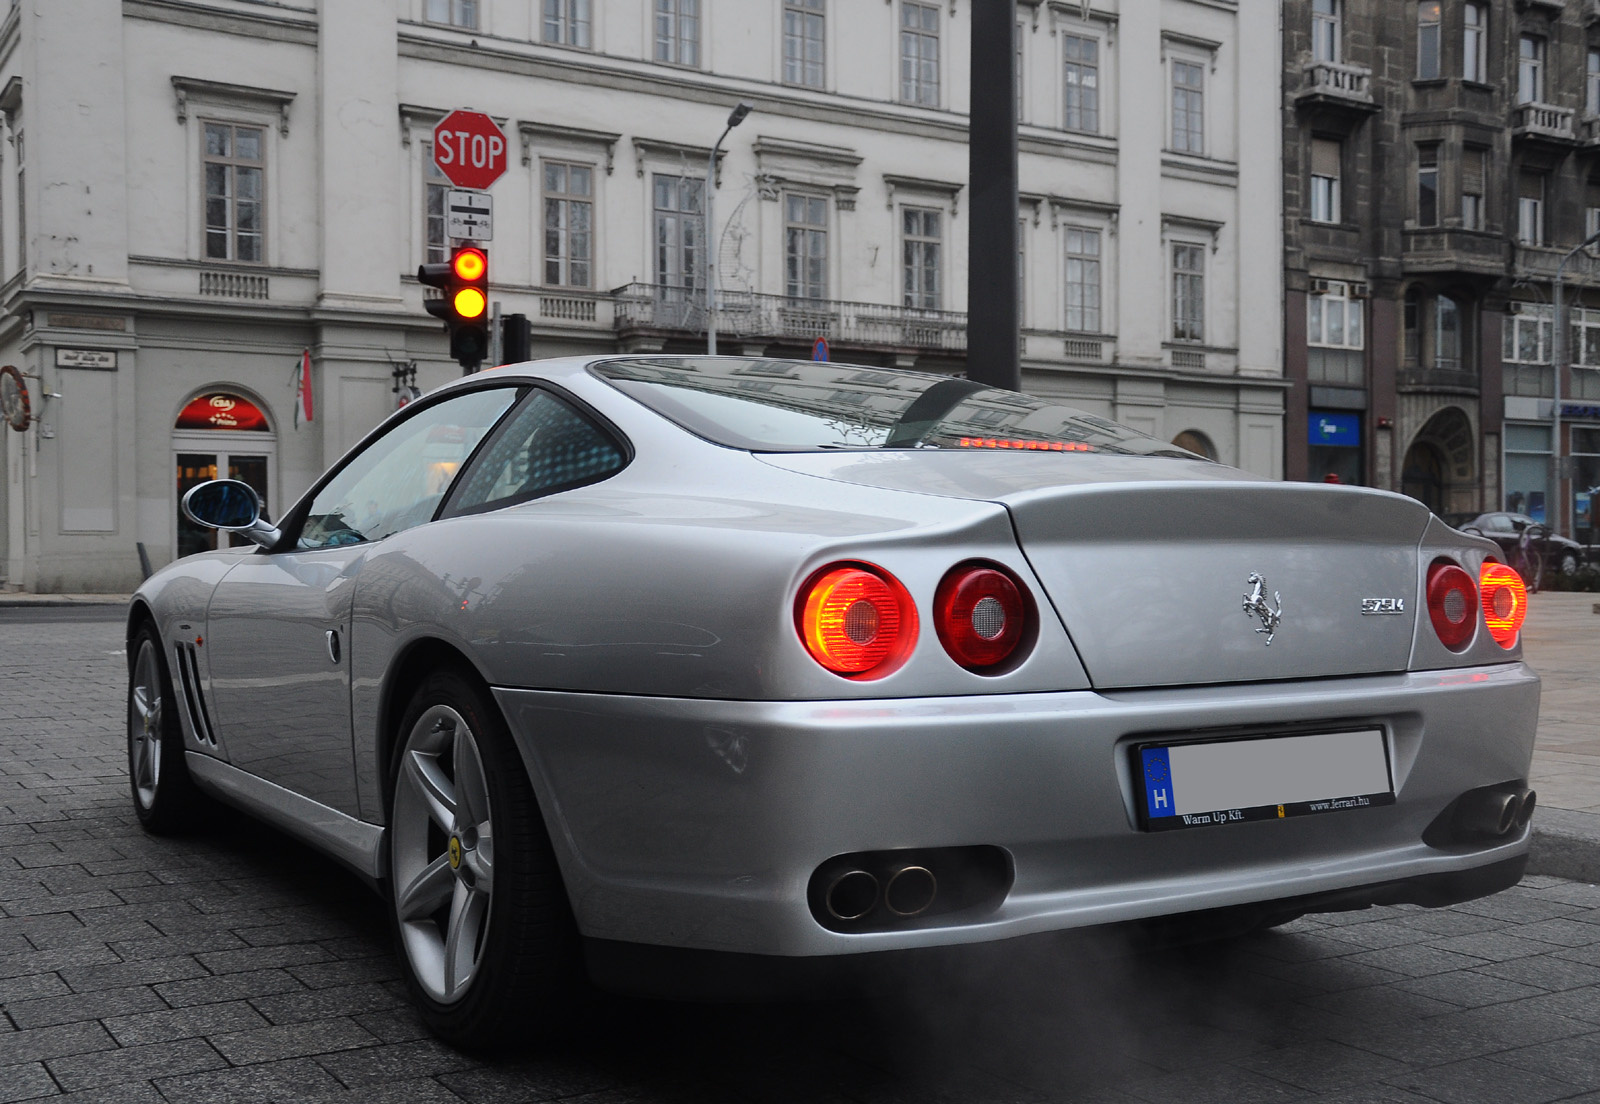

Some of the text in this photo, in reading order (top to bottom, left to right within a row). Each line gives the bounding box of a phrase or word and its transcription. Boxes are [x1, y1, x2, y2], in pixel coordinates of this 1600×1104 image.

[438, 129, 503, 169] STOP
[1153, 788, 1168, 809] H
[1309, 796, 1370, 811] www.ferrari.hu
[1182, 809, 1245, 825] Warm Up Kft.
